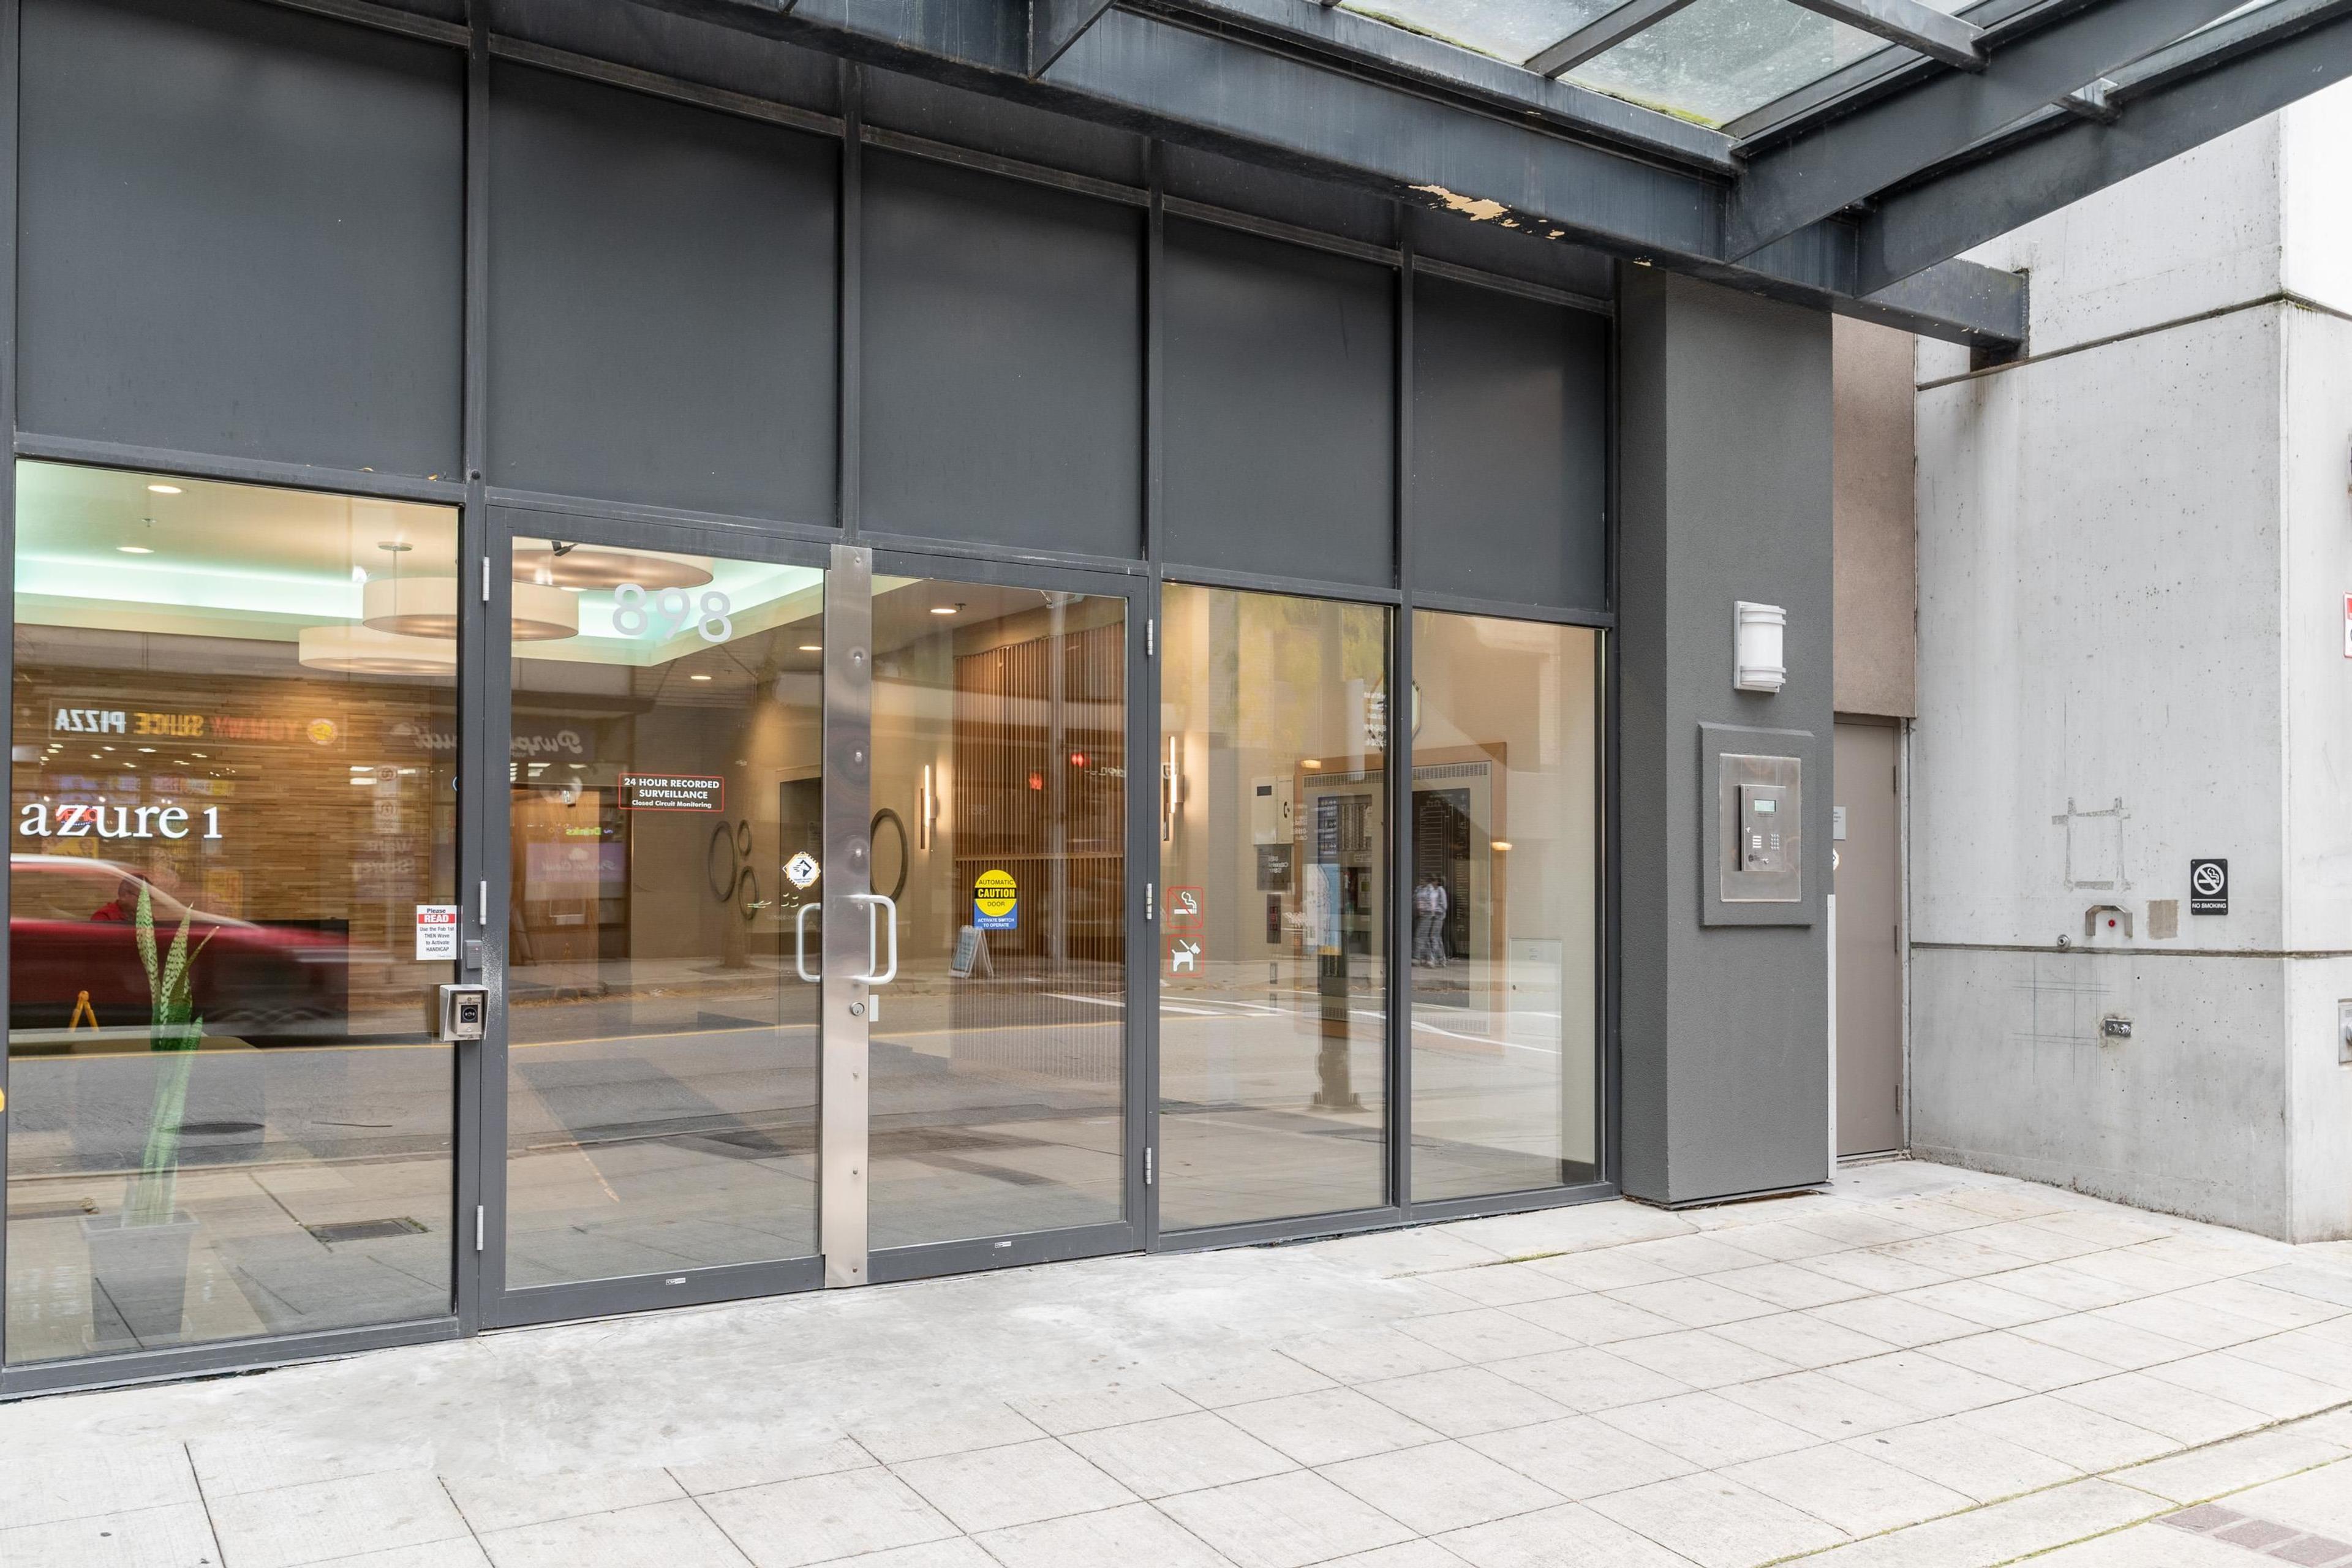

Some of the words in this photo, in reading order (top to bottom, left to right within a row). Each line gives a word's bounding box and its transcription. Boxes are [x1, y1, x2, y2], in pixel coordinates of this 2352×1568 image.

[613, 583, 732, 643] 898
[671, 780, 720, 788] RECORDED
[639, 790, 708, 799] SURVEILLANCE
[20, 803, 189, 839] azure
[203, 806, 222, 839] 1
[978, 889, 1015, 898] CAUTION
